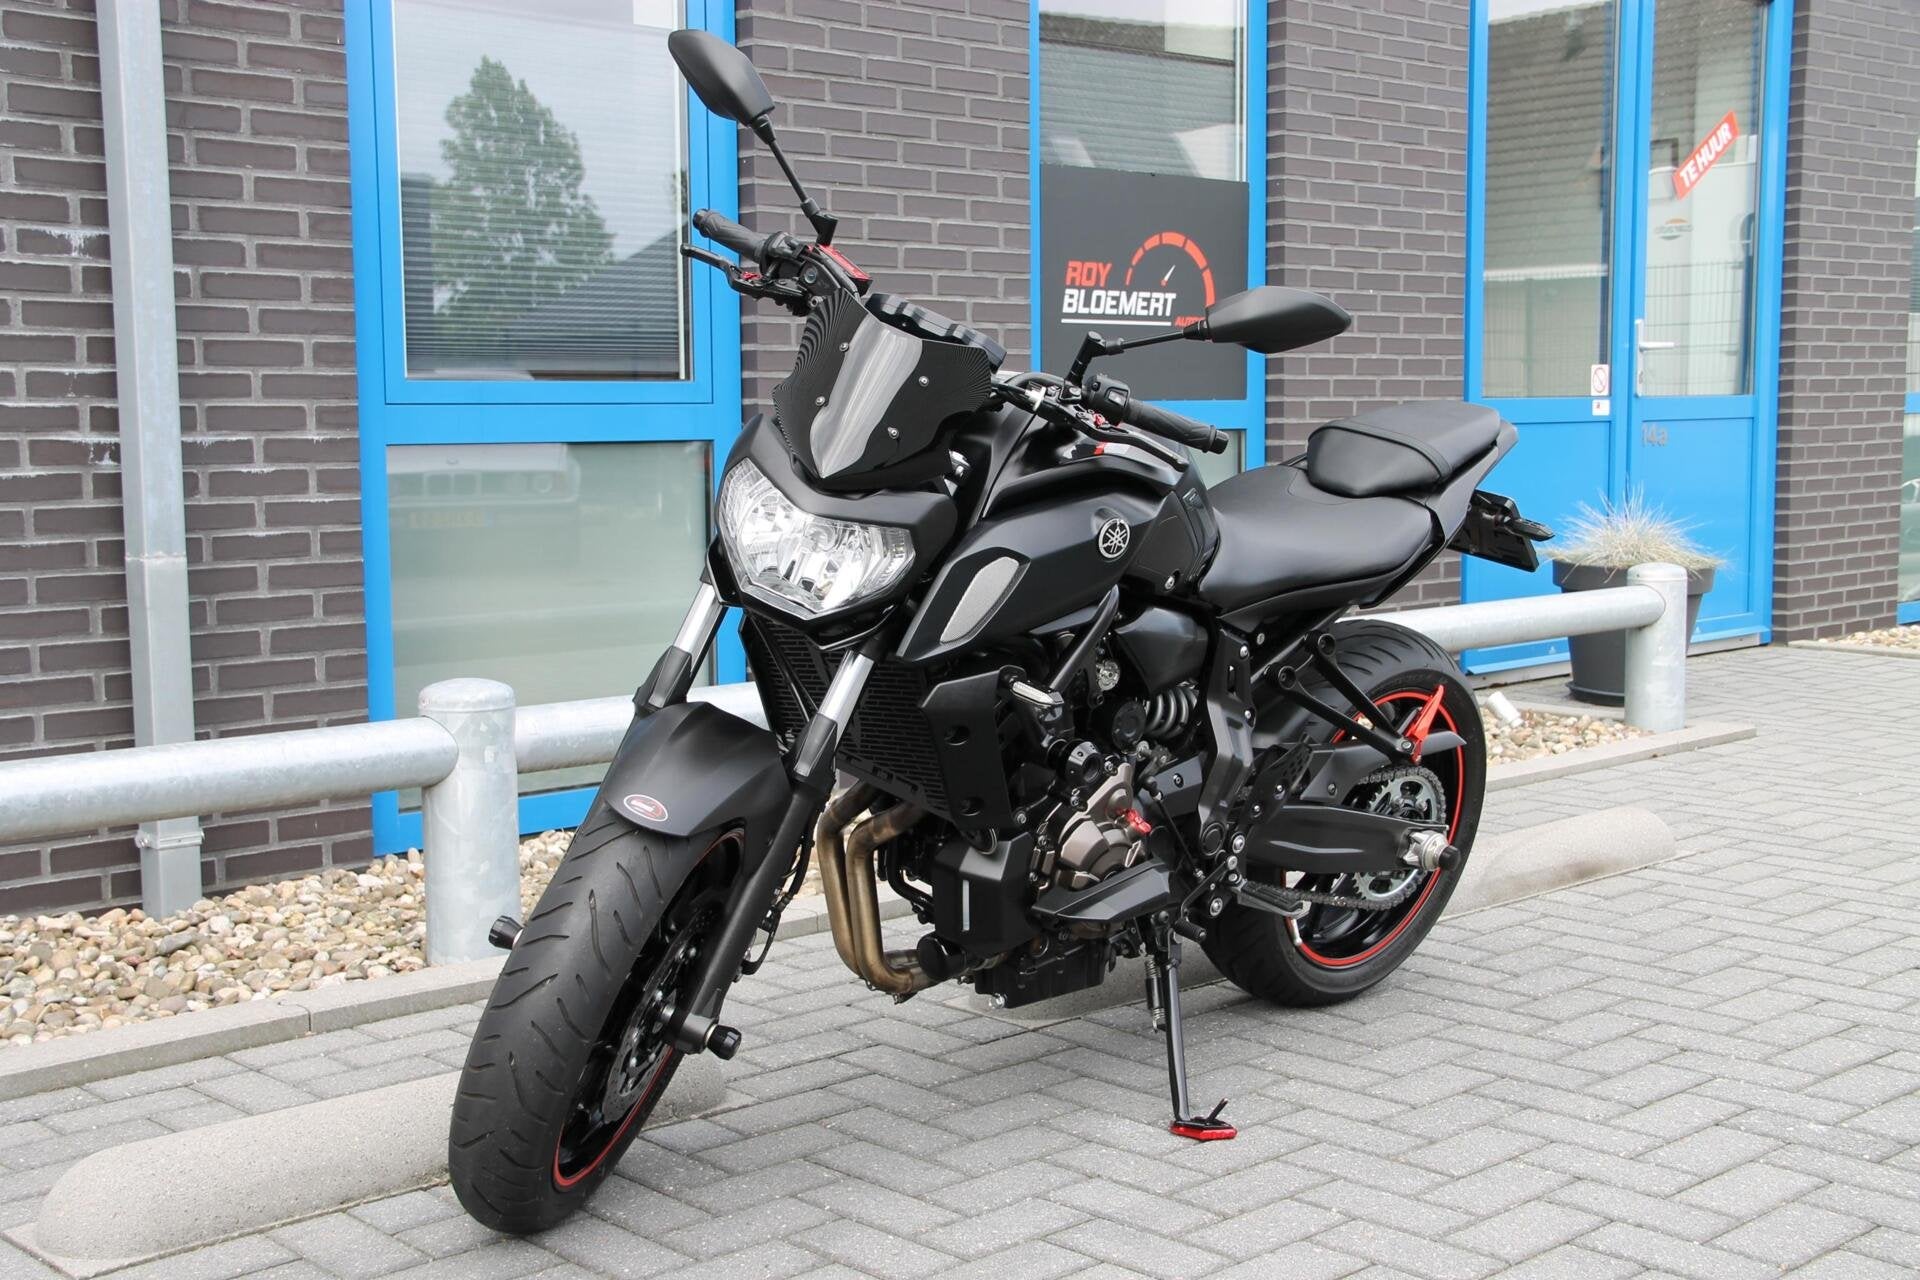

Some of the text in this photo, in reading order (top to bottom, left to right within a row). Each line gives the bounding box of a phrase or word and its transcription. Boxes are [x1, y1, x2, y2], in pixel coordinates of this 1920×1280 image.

[1680, 122, 1732, 188] TE HUUR
[1065, 260, 1112, 287] ROY
[1062, 289, 1176, 316] BLOEMERT
